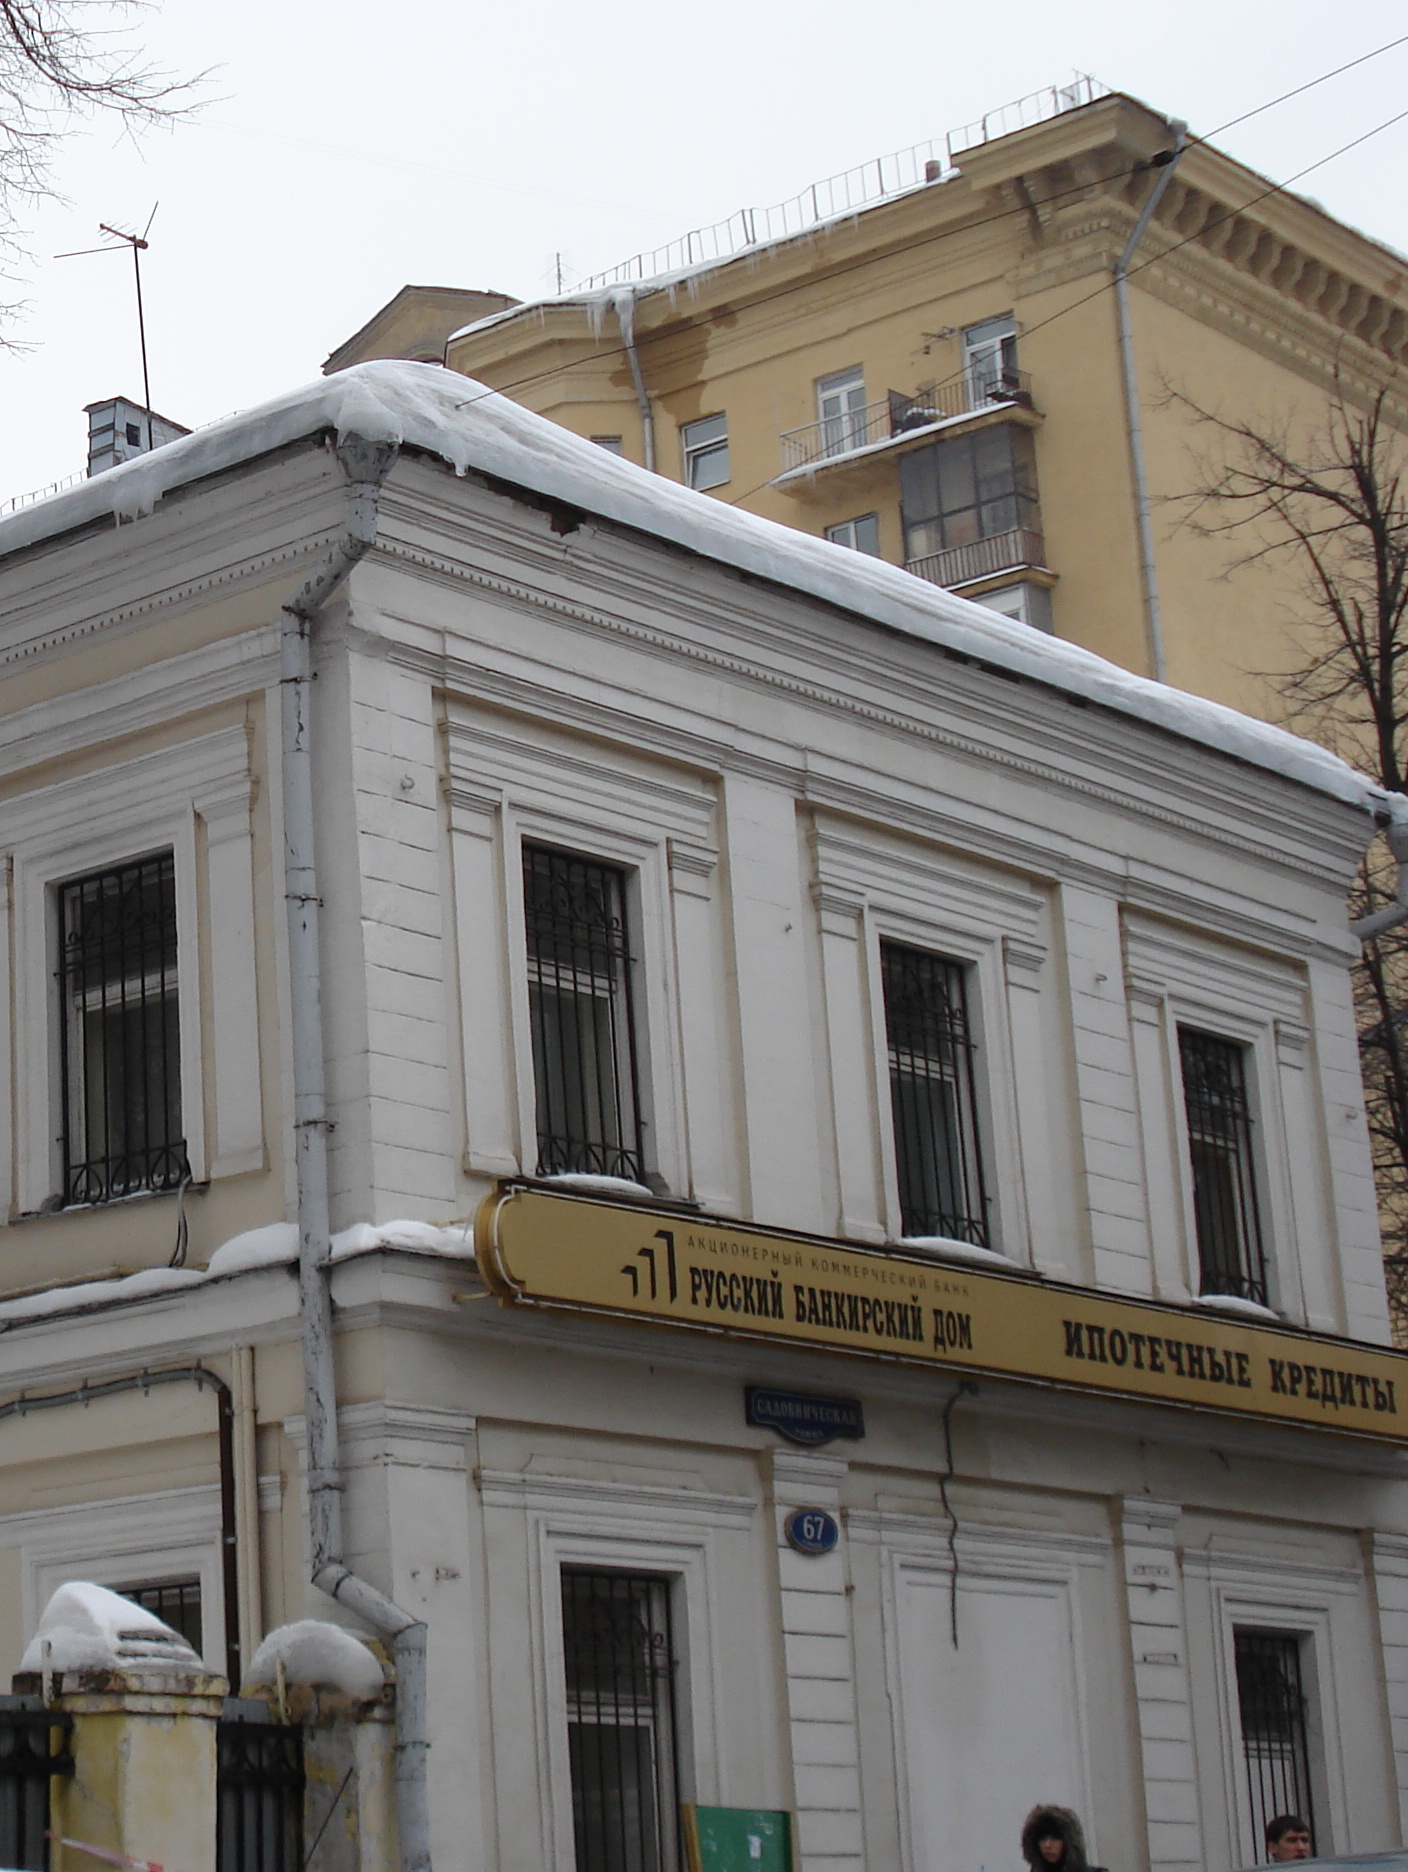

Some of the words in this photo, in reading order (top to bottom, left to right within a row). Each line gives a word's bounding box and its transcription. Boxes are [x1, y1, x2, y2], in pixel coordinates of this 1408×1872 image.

[688, 1235, 803, 1269] АКЦИОНЕРНЫЙ
[811, 1259, 927, 1289] КОММЕРЧЕСКИЙ
[934, 1279, 970, 1297] БАНК
[689, 1265, 785, 1320] РУССКИЙ
[793, 1284, 925, 1343] БАНКИРСКИЙ
[933, 1307, 974, 1354] ДОМ
[1062, 1319, 1252, 1390] ИПОТЕЧНЫЕ
[1268, 1357, 1398, 1415] КРЕДИТЫ
[803, 1515, 824, 1540] 67
